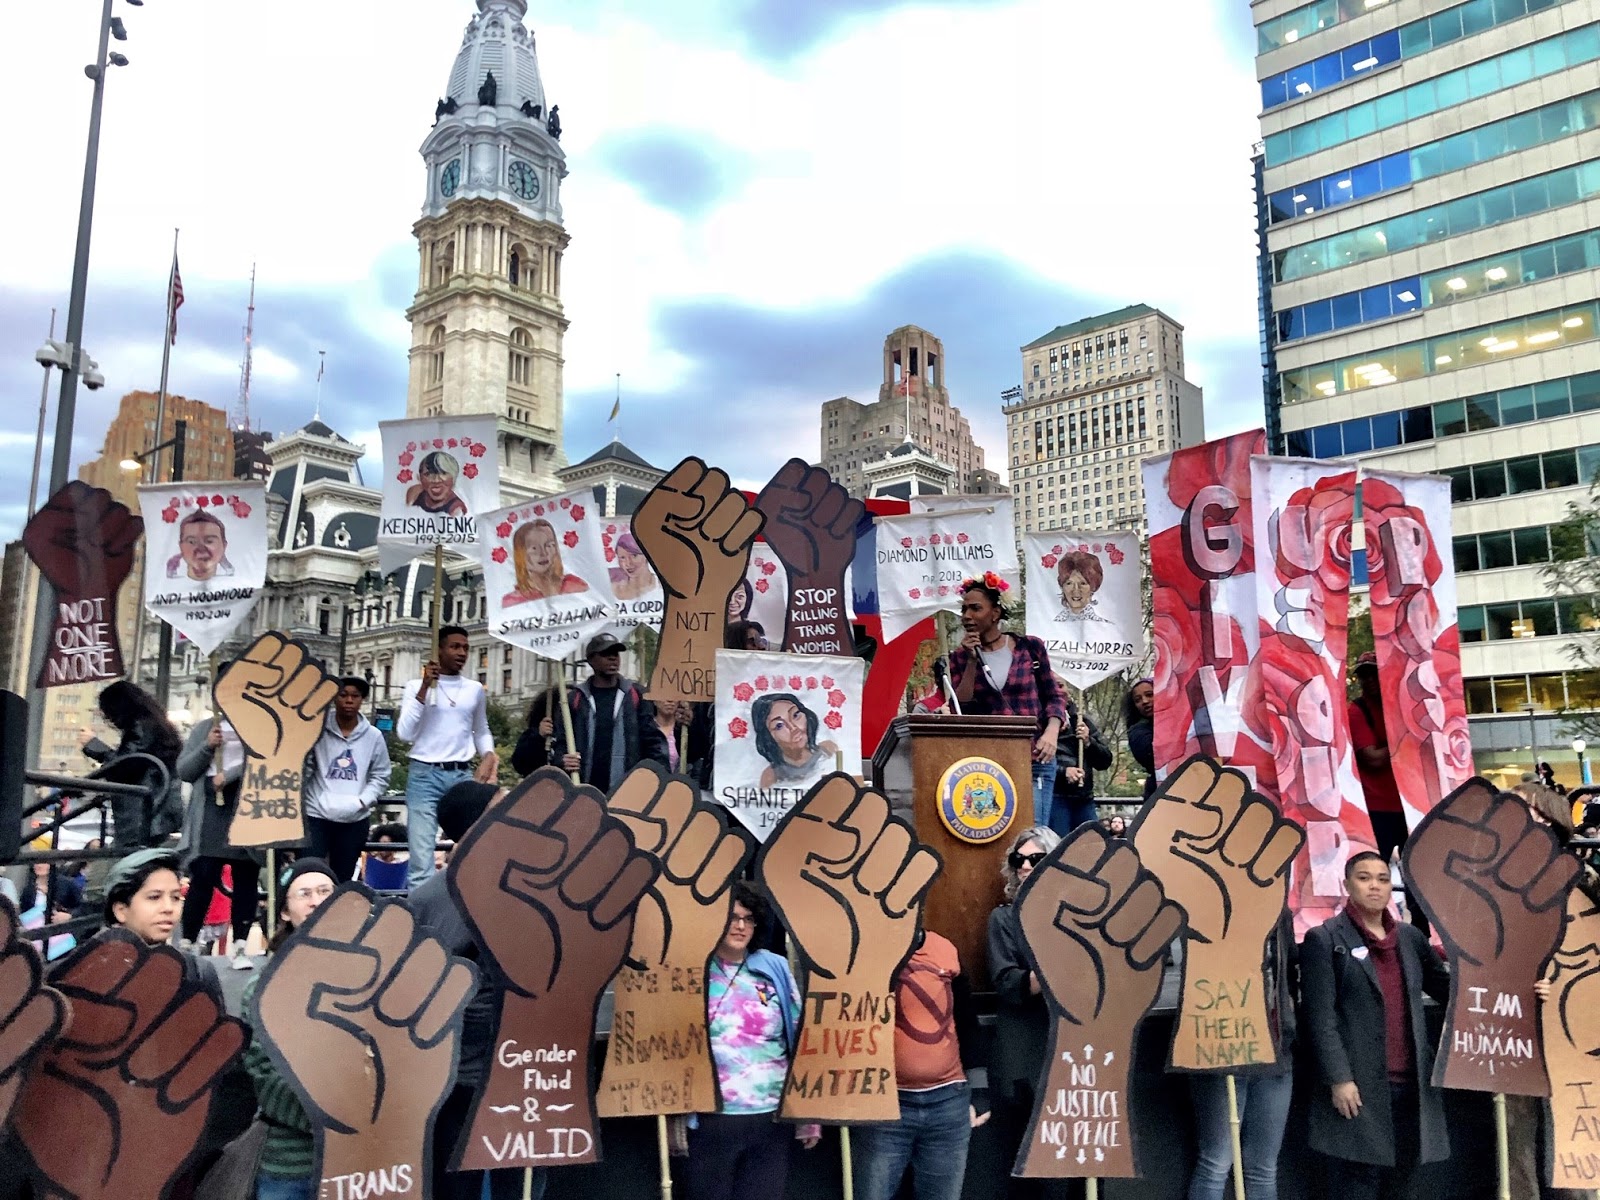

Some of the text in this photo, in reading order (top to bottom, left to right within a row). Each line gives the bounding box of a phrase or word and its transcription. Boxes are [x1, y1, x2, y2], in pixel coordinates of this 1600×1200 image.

[382, 517, 436, 535] KEISHA
[415, 533, 475, 544] 1993-2015
[878, 544, 994, 564] DIAMOND WILLIAMS
[939, 571, 962, 582] 2013
[151, 587, 254, 605] ANDI WOODHOUSE
[794, 588, 837, 606] STOP
[60, 597, 106, 624] NOT
[547, 603, 608, 627] BLAHNIK
[676, 610, 717, 632] NOT
[791, 607, 839, 622] KILLING
[55, 622, 110, 649] ONE
[794, 623, 836, 638] TRANS
[680, 637, 699, 664] 1
[792, 640, 841, 654] WOMEN
[1085, 641, 1134, 656] MORRIS
[48, 648, 117, 683] MORE
[1061, 659, 1110, 671] 1955-2002
[660, 667, 716, 698] MORE
[954, 763, 1001, 778] MAYOR OF
[722, 785, 789, 810] SHANTE
[950, 815, 1011, 839] PHILADELPHIA
[1194, 978, 1251, 1010] SAY
[1467, 986, 1523, 1019] I AM
[806, 990, 897, 1025] TRANS
[614, 1010, 706, 1066] HUMAN
[1187, 1014, 1257, 1040] THEIR
[800, 1023, 882, 1058] LIVES
[1454, 1029, 1533, 1059] HUMAN
[498, 1039, 577, 1069] Gender
[1196, 1041, 1260, 1066] NAME
[523, 1068, 571, 1091] Fluid
[787, 1067, 891, 1099] MATTER
[1070, 1063, 1097, 1087] NO
[1045, 1088, 1121, 1118] JUSTICE
[1565, 1081, 1597, 1109] I
[482, 1127, 593, 1162] VALID
[1040, 1120, 1122, 1147] NO PEACE
[329, 1163, 414, 1200] TRANS
